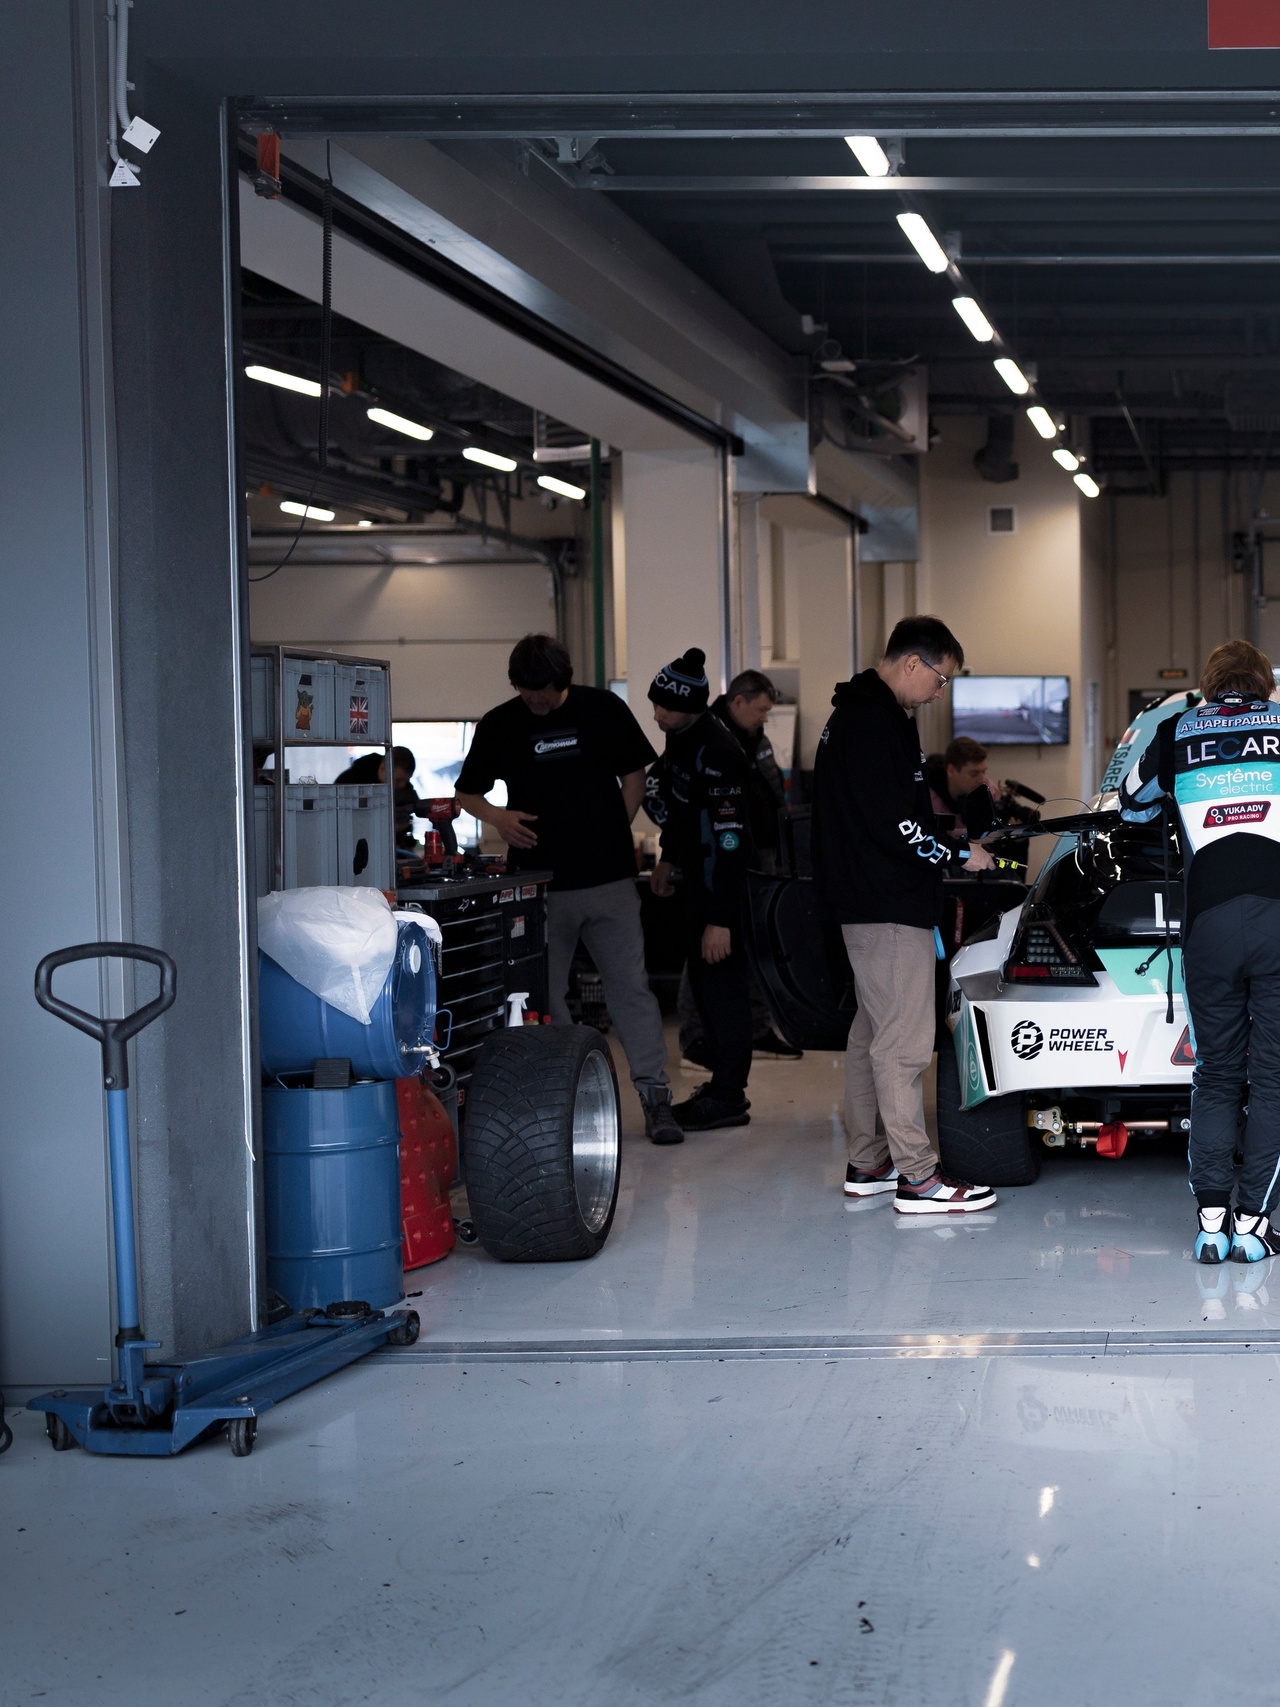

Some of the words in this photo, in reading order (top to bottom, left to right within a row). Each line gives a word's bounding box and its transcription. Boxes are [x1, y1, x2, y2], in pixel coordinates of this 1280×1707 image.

[655, 673, 691, 697] CAR
[1180, 724, 1192, 733] А.
[1187, 735, 1280, 765] LECAR
[1196, 768, 1273, 788] Systême
[1220, 782, 1274, 796] electric
[1223, 806, 1247, 815] YUKA
[1247, 804, 1264, 813] ADV
[1049, 1028, 1108, 1040] POWER
[1048, 1040, 1115, 1051] WHEELS
